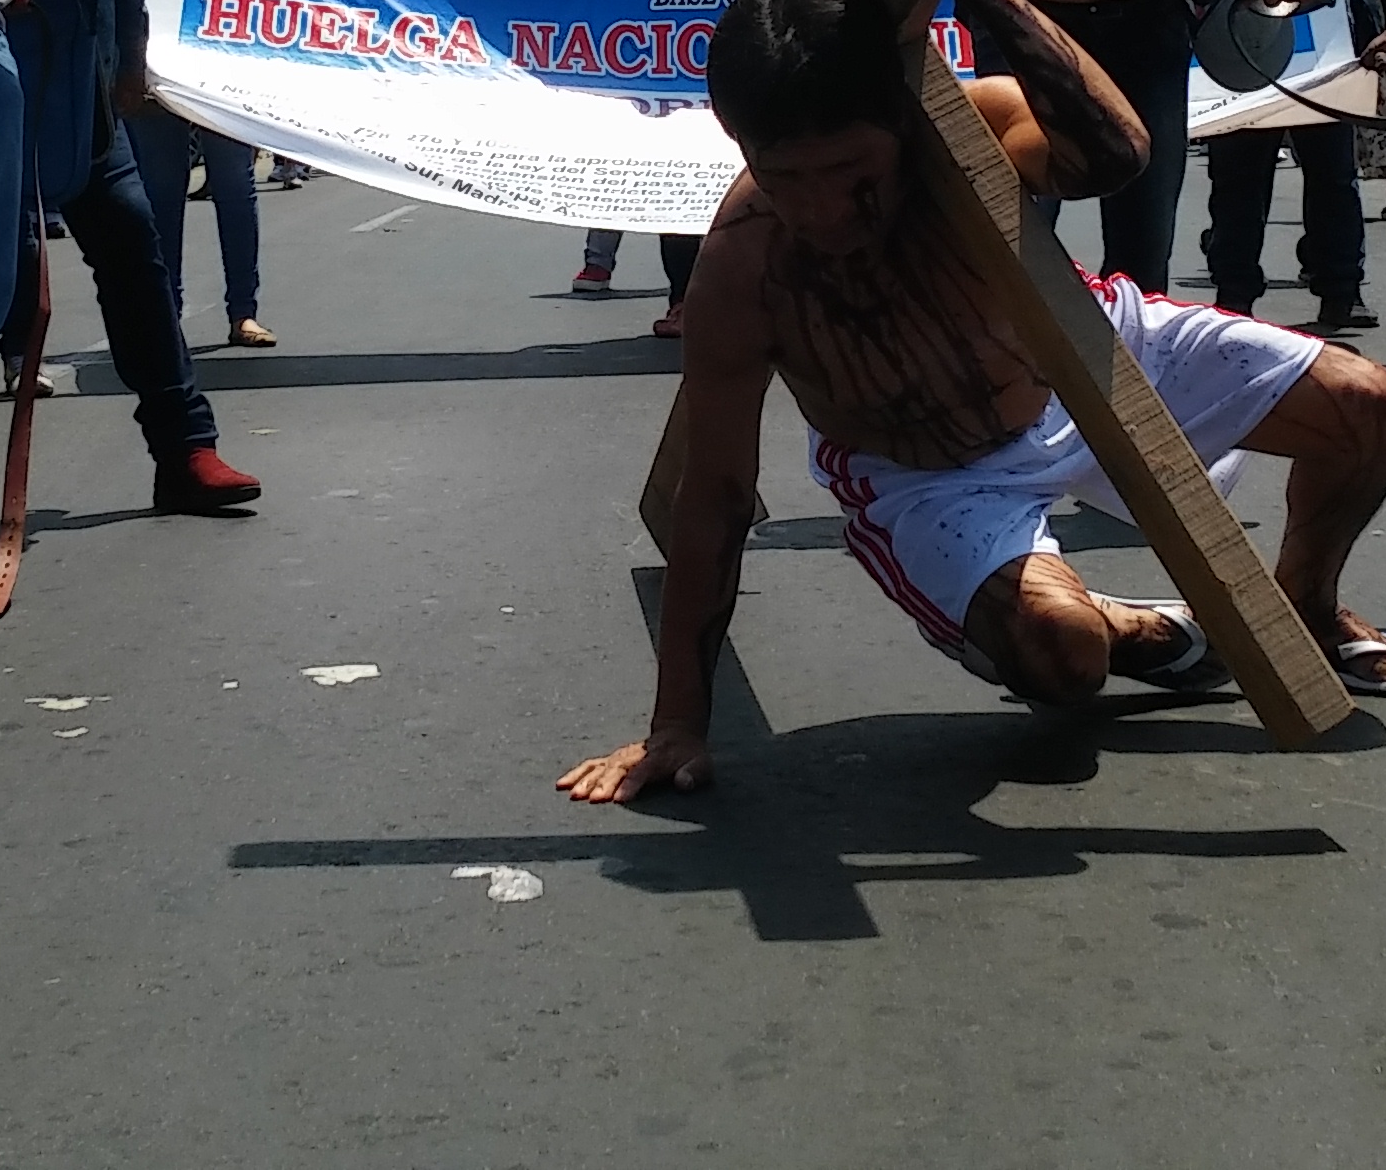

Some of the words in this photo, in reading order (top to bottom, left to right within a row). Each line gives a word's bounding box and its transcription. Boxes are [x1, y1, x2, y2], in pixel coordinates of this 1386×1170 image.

[485, 160, 505, 169] la
[552, 165, 587, 175] del
[593, 167, 686, 179] Servicio
[490, 152, 540, 162] para
[548, 154, 567, 163] la
[574, 156, 702, 170] aprobación
[709, 161, 736, 171] de
[592, 178, 627, 186] del
[551, 191, 675, 204] sentencias
